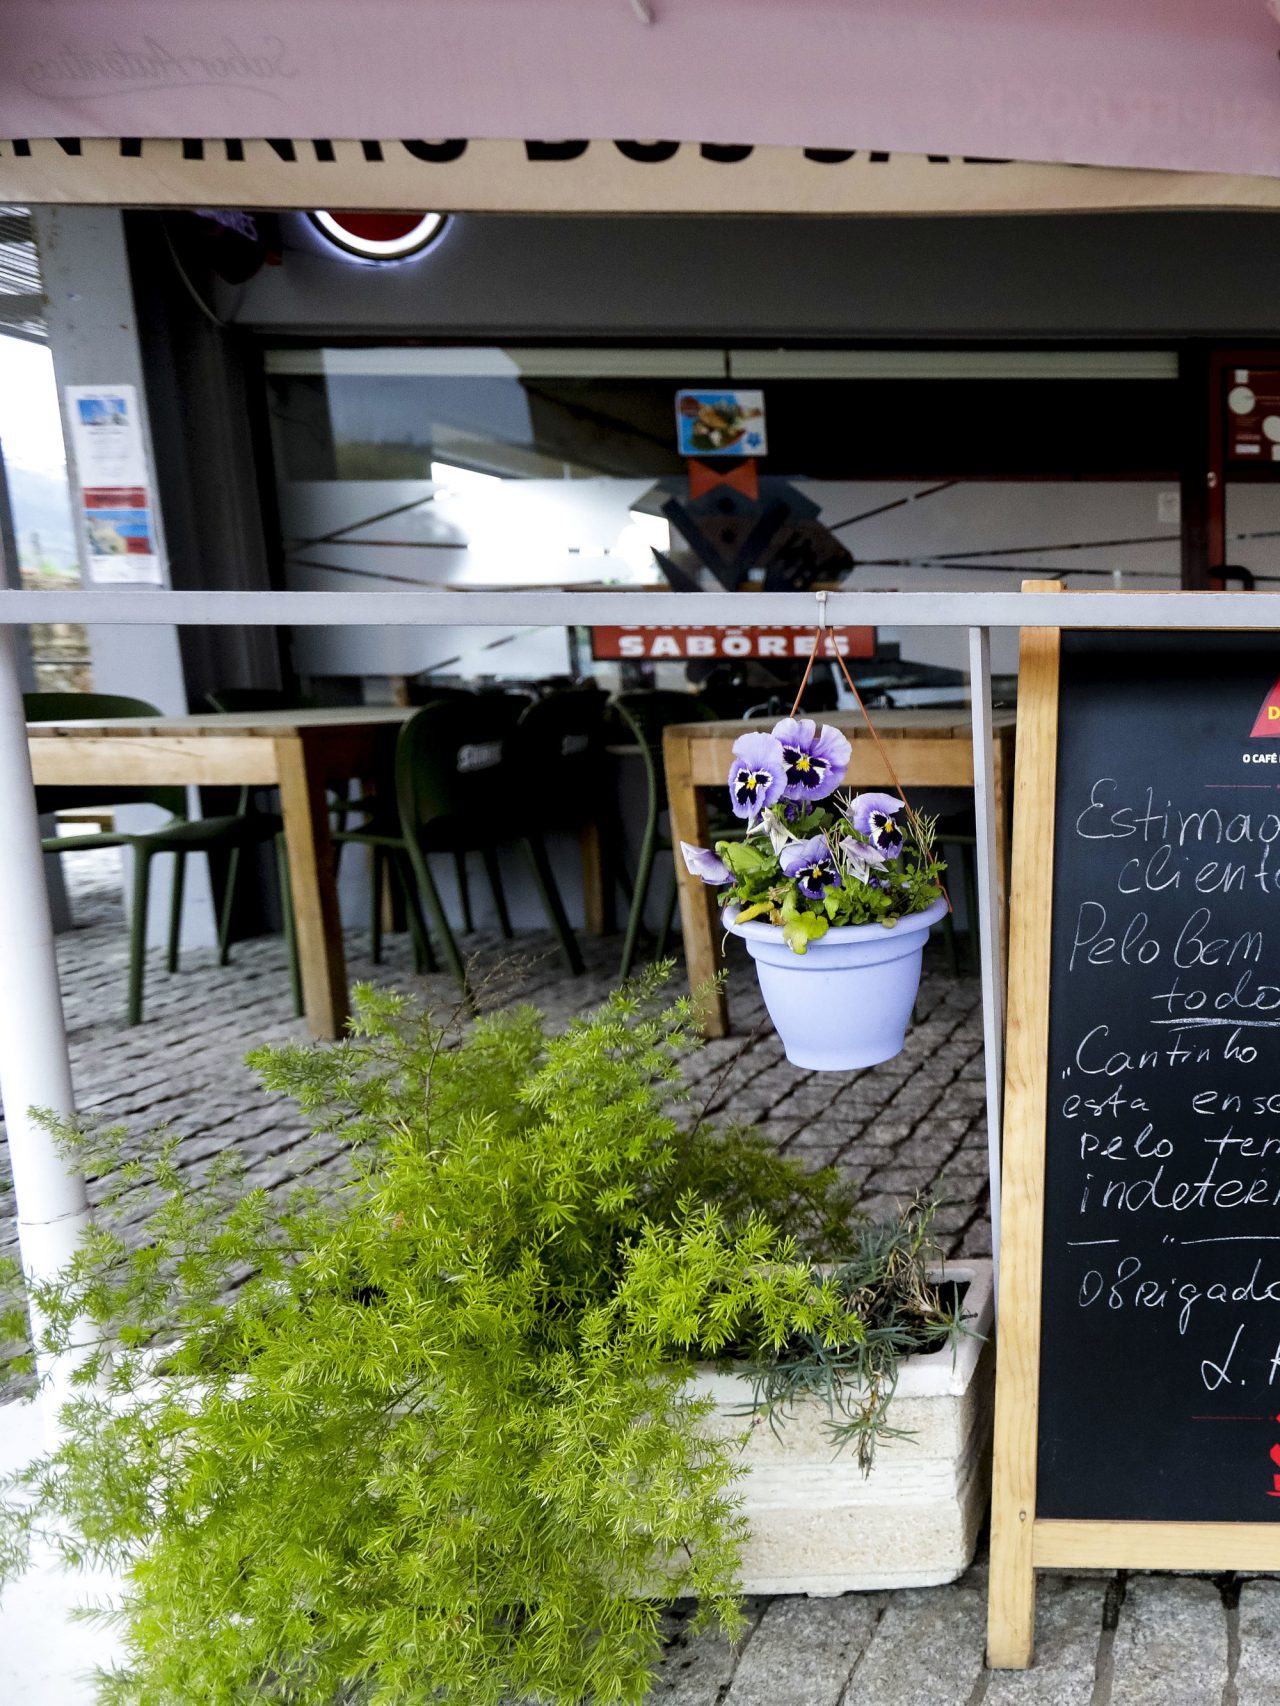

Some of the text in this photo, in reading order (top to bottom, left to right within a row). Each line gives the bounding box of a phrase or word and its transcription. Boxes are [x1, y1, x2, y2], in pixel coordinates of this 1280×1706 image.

[618, 635, 850, 657] SABORES
[1242, 754, 1251, 764] O
[1252, 752, 1278, 764] CAFÉ
[1069, 901, 1160, 973] Pelo
[1062, 1084, 1149, 1119] esta
